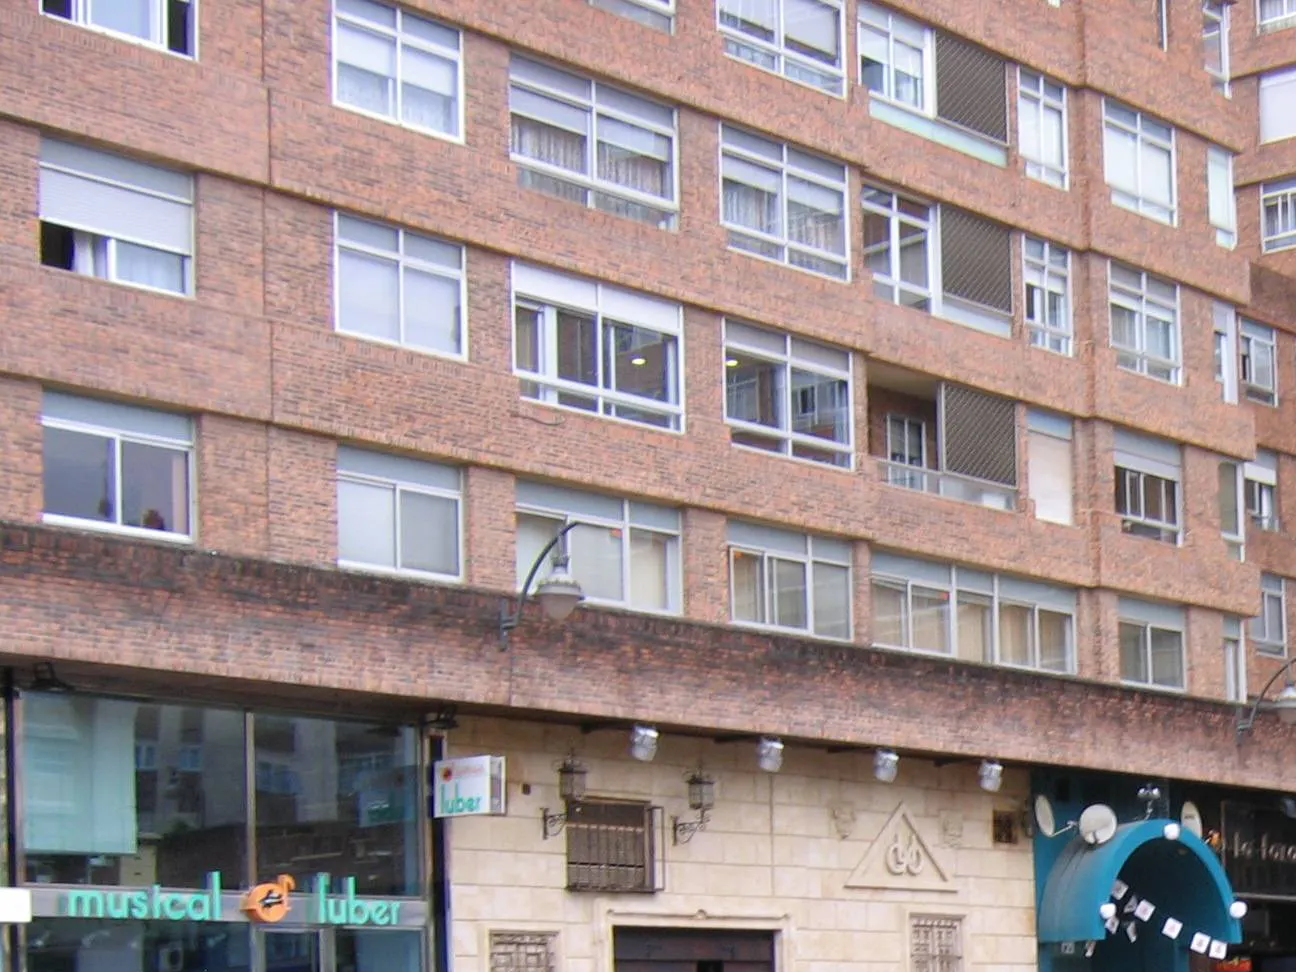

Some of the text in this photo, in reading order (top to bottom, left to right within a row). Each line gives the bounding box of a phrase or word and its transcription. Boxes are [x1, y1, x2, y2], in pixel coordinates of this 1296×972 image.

[440, 784, 482, 814] luber
[67, 871, 402, 926] musical luber
